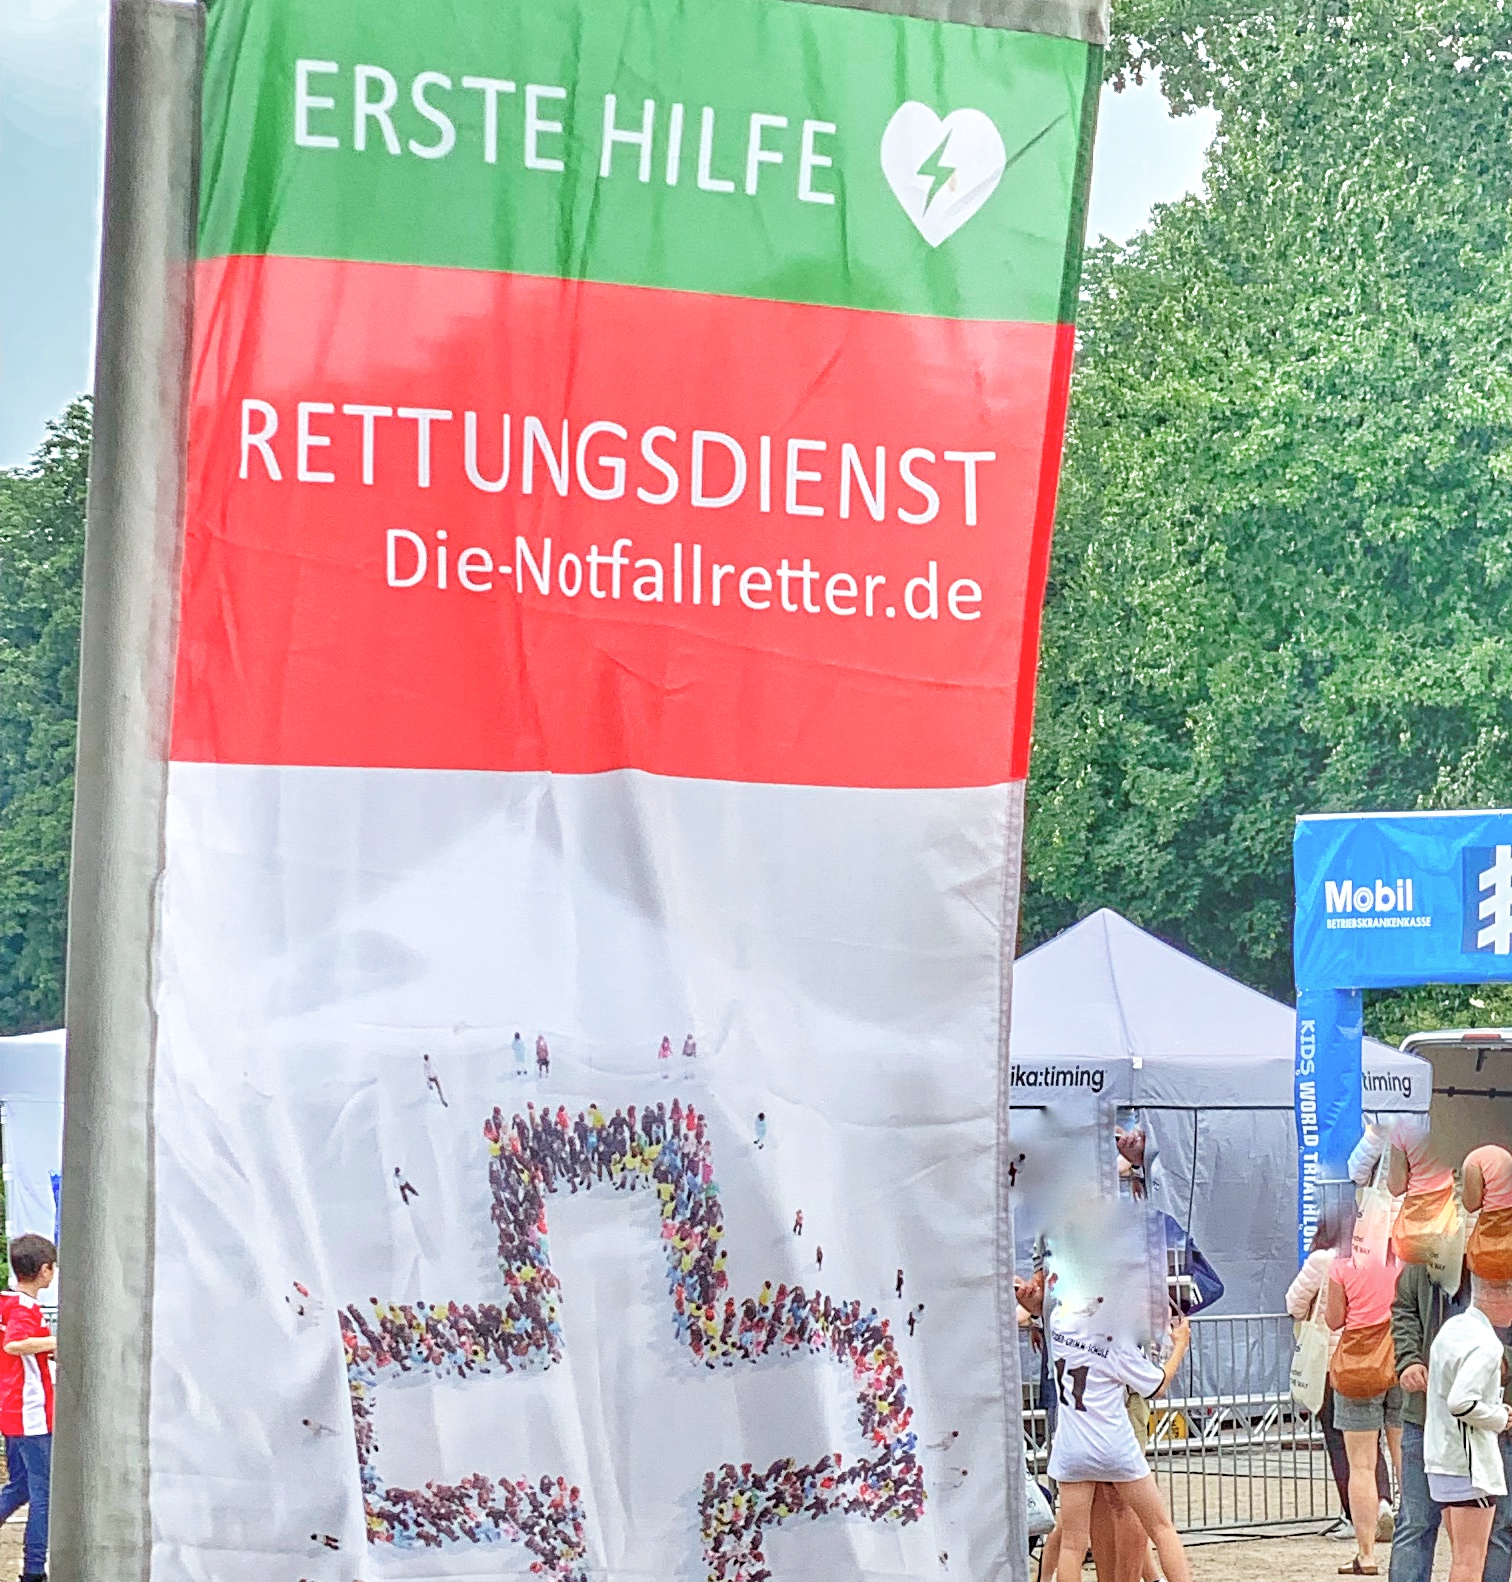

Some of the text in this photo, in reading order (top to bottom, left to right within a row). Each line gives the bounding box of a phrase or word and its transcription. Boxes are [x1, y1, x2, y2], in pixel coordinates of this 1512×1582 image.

[295, 58, 837, 205] ERSTE HILFE
[237, 399, 997, 527] RETTUNGSDIENST
[385, 527, 983, 621] Die-Notfallretter.de
[1324, 878, 1413, 912] Mobil
[1326, 916, 1431, 929] BETRIEBSKRANKENKASSE
[1010, 1064, 1105, 1092] ika:timing
[1300, 1019, 1315, 1076] KIDS
[1300, 1081, 1319, 1147] WORLD
